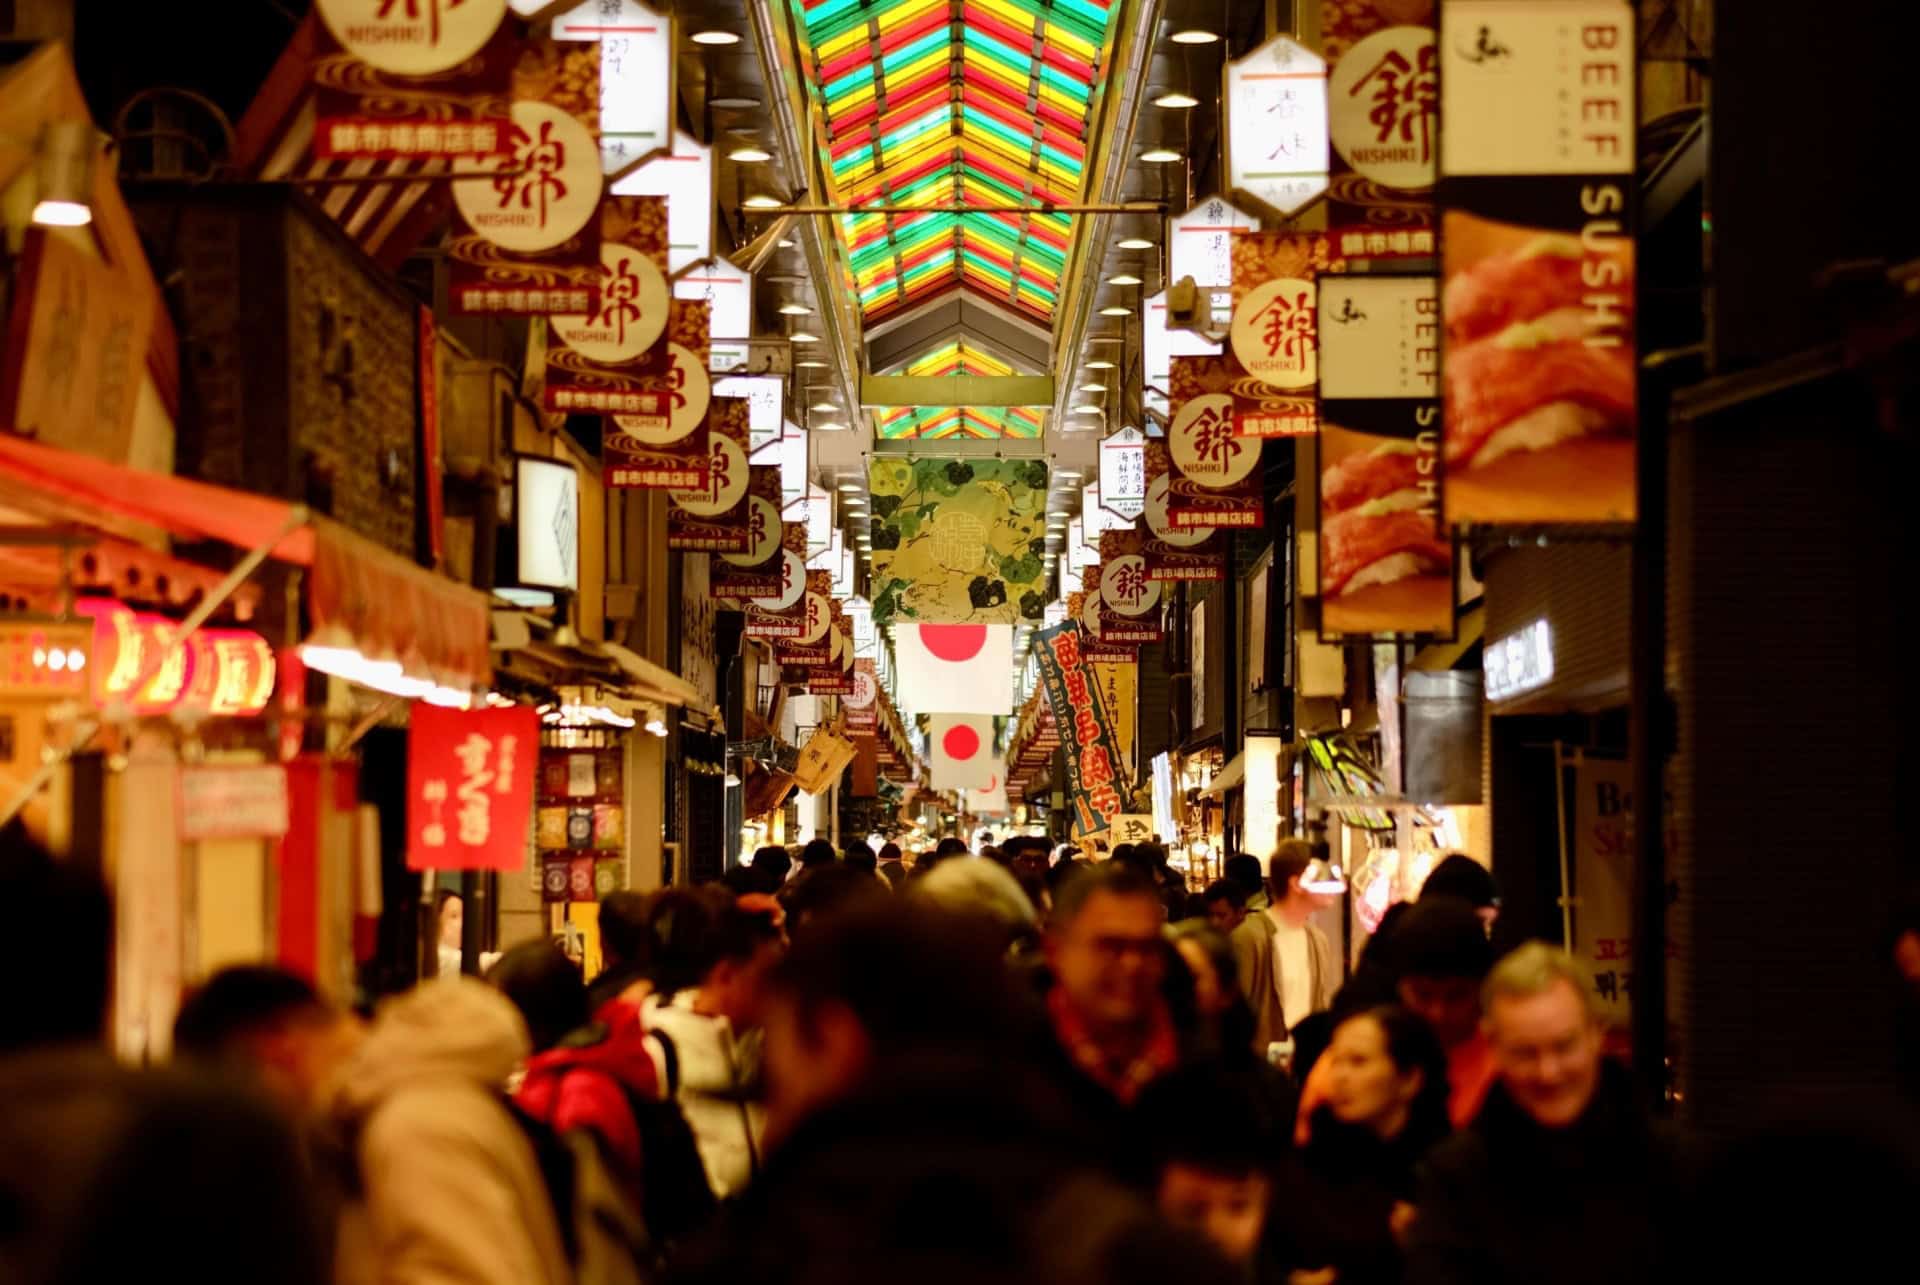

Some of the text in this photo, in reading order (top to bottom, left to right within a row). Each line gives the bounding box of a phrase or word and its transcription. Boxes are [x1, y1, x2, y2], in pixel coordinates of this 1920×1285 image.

[1351, 44, 1435, 166] 錦
[1582, 24, 1620, 157] BEEF
[1352, 147, 1416, 164] NISHIKI
[1581, 185, 1622, 348] SUSHI
[1249, 291, 1320, 372] 錦
[1416, 298, 1438, 384] BEEF
[1250, 360, 1296, 370] NISHIKI
[1183, 405, 1242, 476] 錦
[1183, 463, 1221, 473] NISHIKI
[1416, 407, 1438, 515] SUSHI
[1177, 511, 1256, 525] 錦市場商店街
[1109, 561, 1149, 608] 錦
[1151, 567, 1217, 579] 錦市場商店街
[1105, 631, 1158, 641] 錦市場商店街
